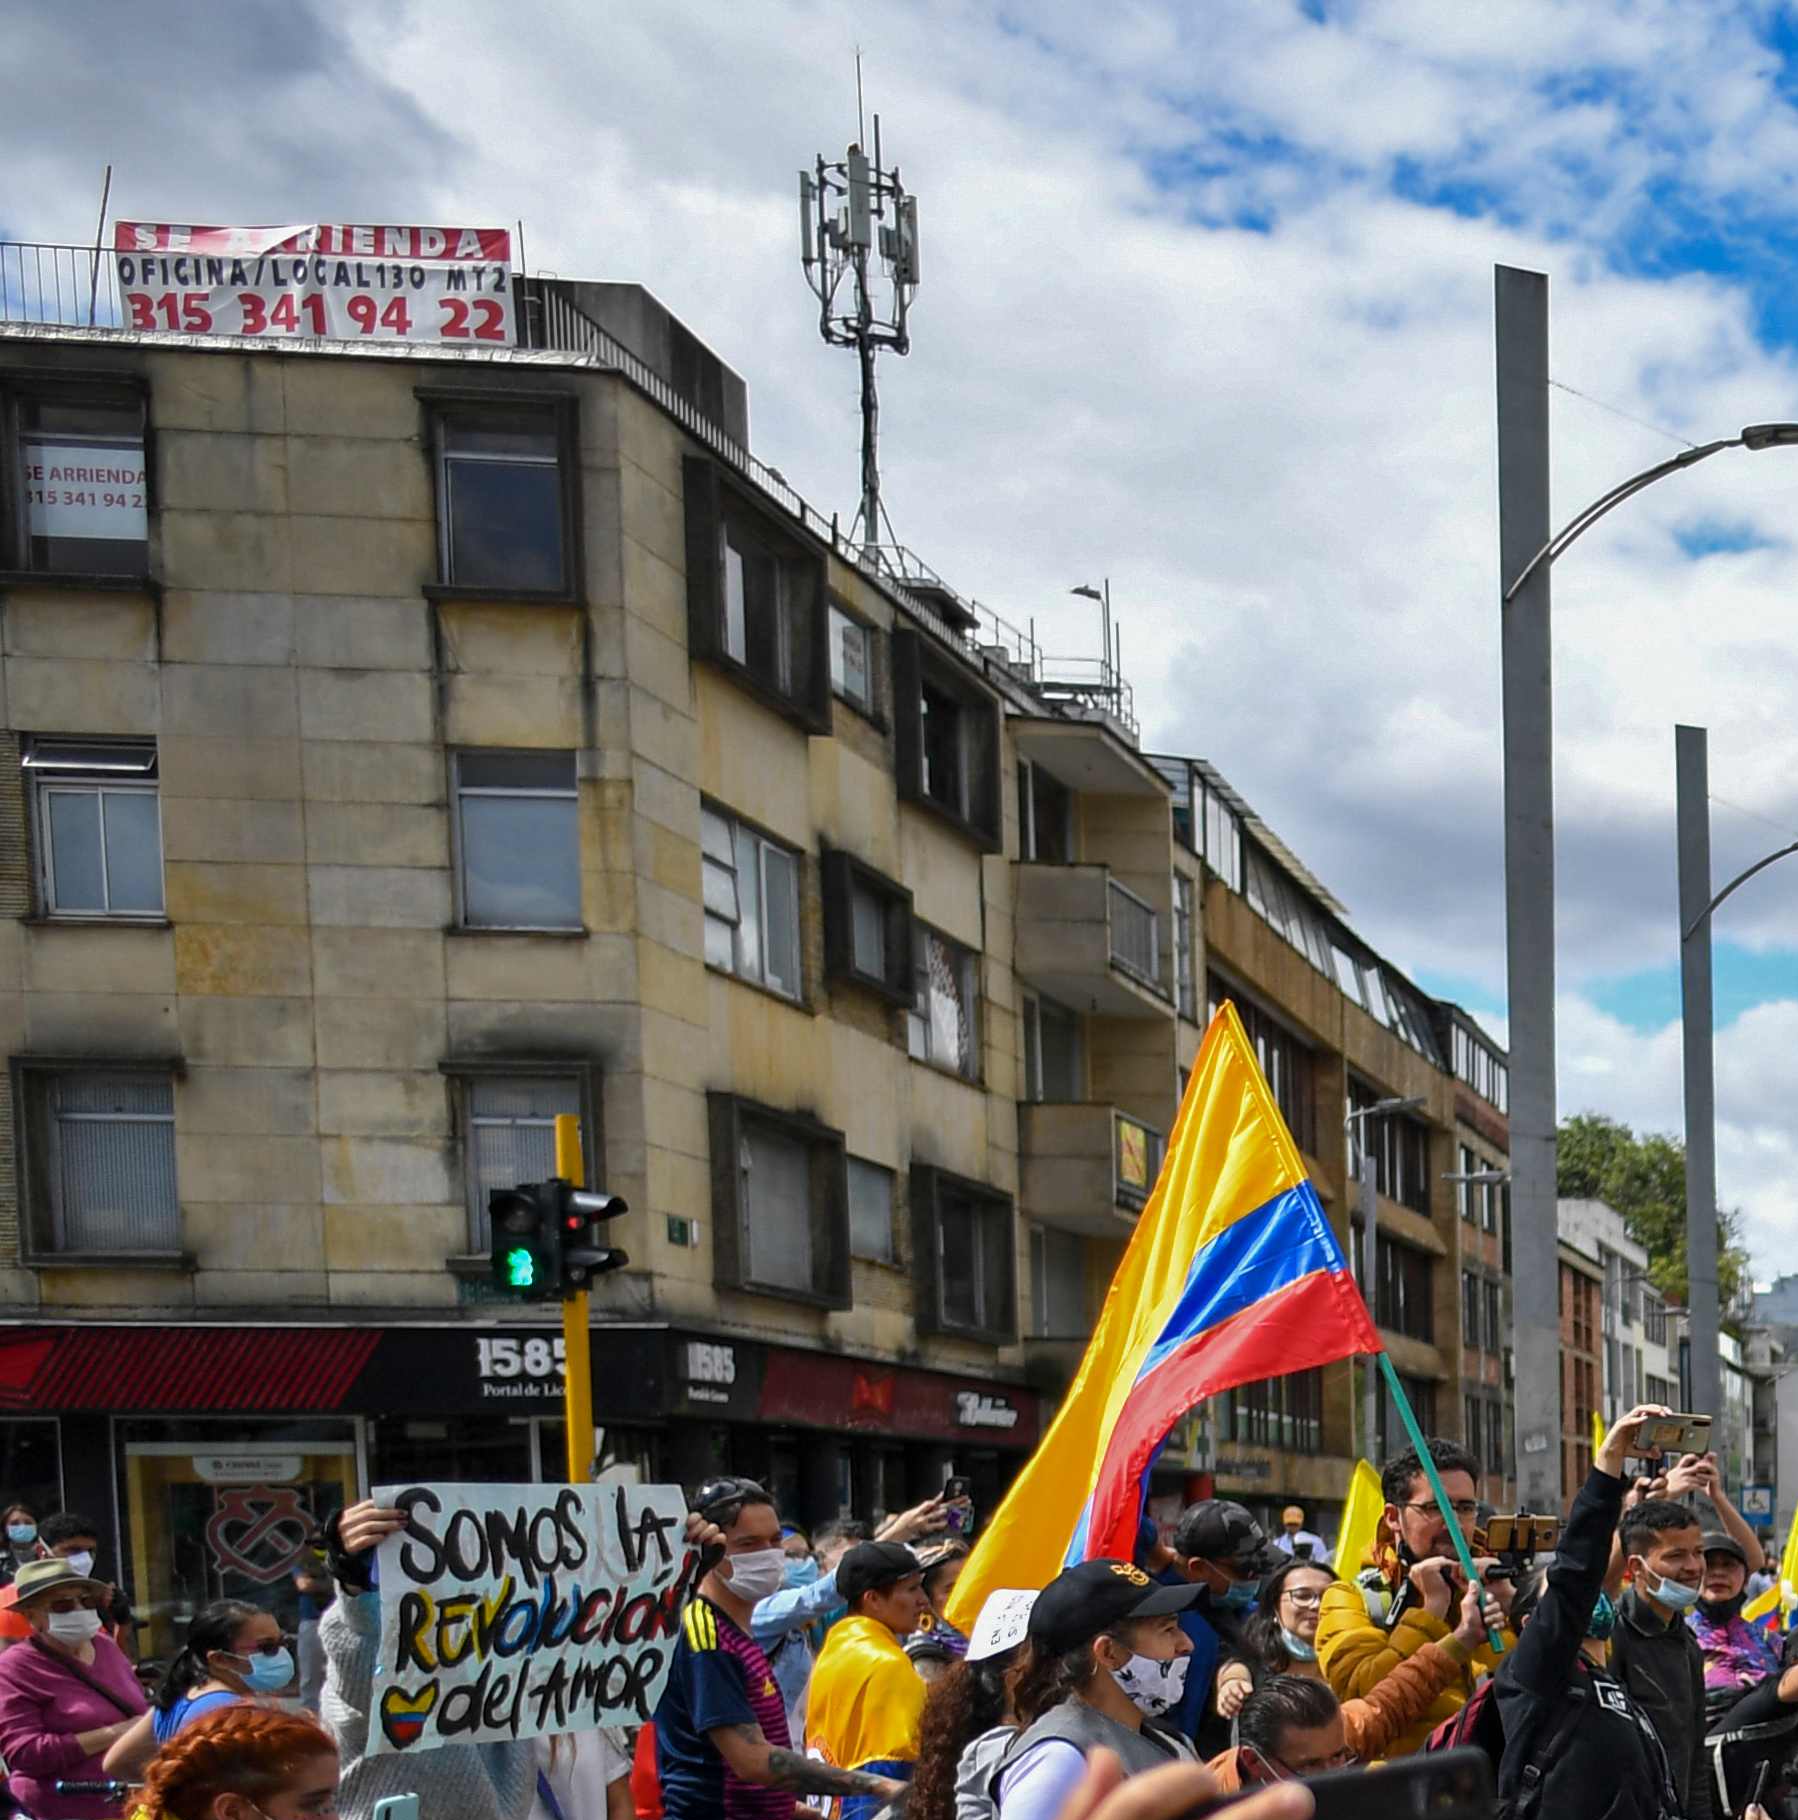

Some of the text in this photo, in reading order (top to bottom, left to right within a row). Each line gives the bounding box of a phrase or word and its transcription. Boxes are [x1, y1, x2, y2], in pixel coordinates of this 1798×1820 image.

[133, 223, 484, 258] SE ARIENDA
[446, 266, 507, 293] MT2
[126, 292, 505, 341] 315 341 94 22
[49, 467, 146, 485] ARRIENDA
[64, 491, 97, 507] 341
[103, 493, 127, 508] 94
[131, 494, 146, 509] 2
[483, 1382, 523, 1398] Portal
[524, 1381, 541, 1397] de
[395, 1486, 588, 1590] SOMOS
[436, 1647, 665, 1742] del AMOR
